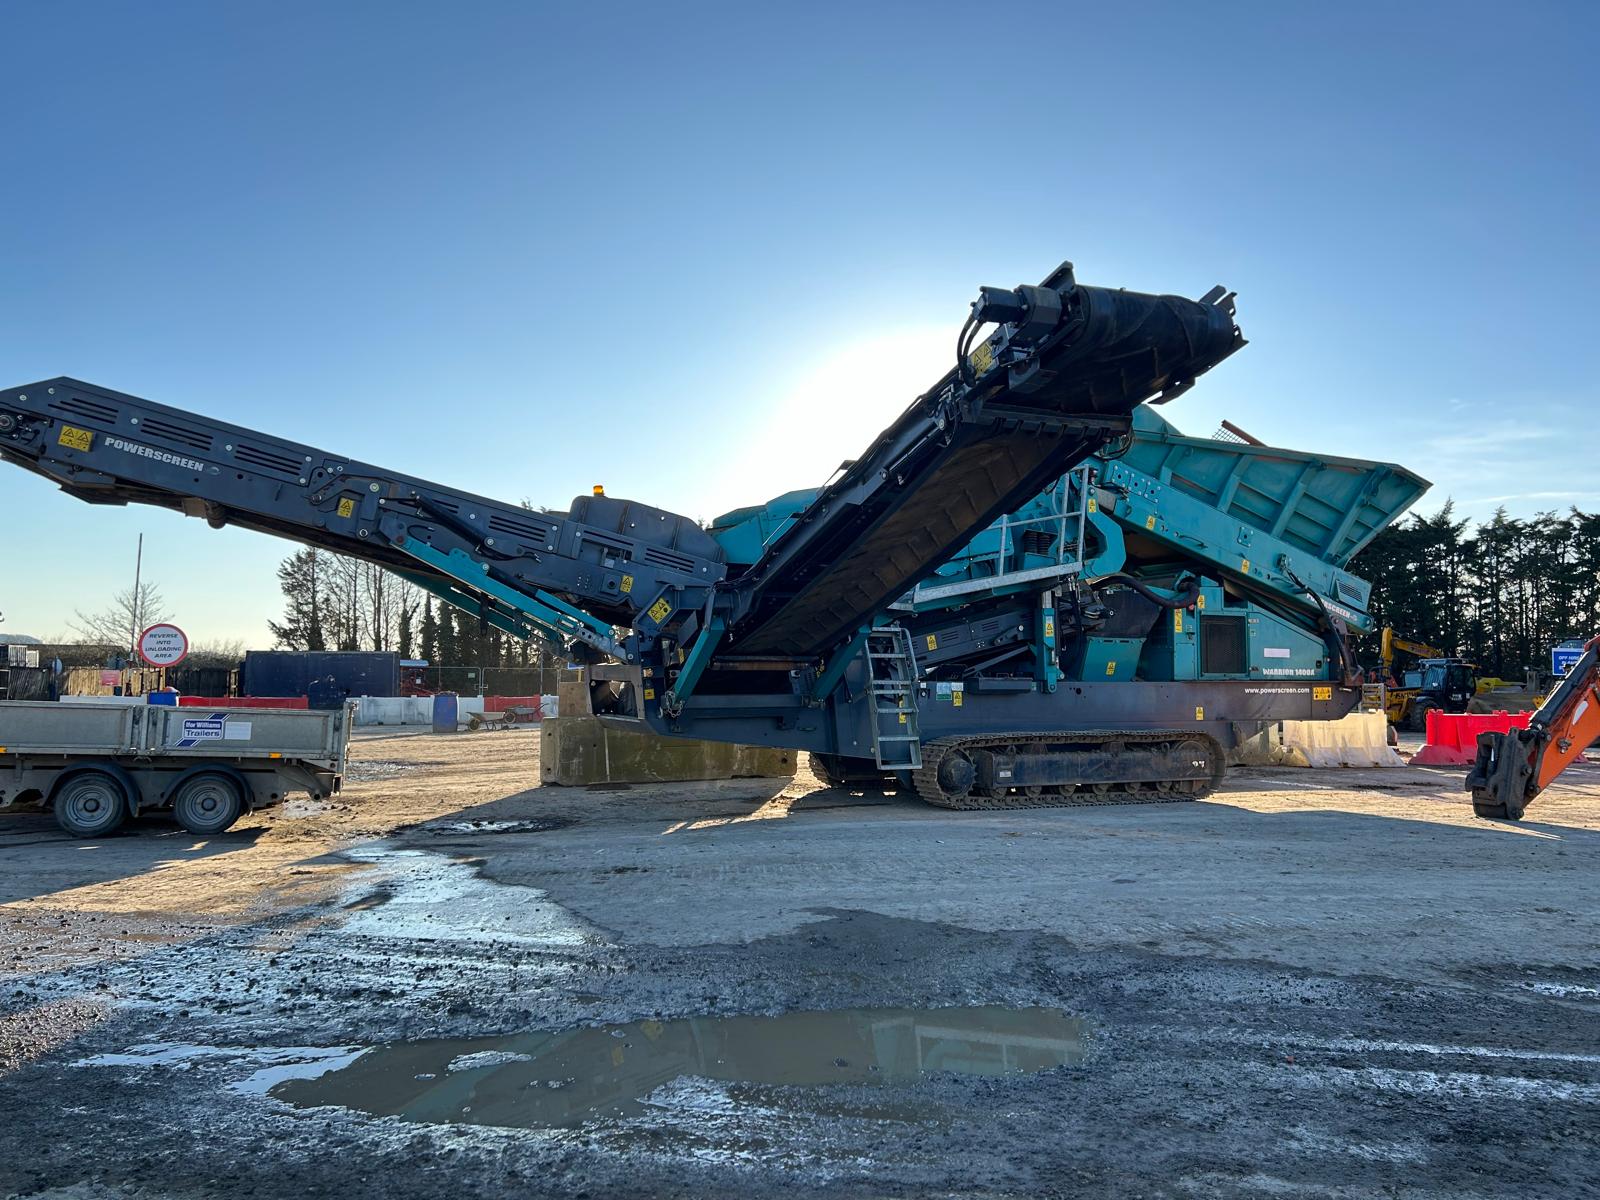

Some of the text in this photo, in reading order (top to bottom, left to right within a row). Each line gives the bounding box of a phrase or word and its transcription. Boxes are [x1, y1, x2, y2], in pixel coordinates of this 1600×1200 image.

[104, 437, 204, 472] POWERSCREEN
[1262, 668, 1294, 676] WARRIOR
[1244, 687, 1310, 695] www.powerscreen.com
[196, 721, 221, 729] Williams
